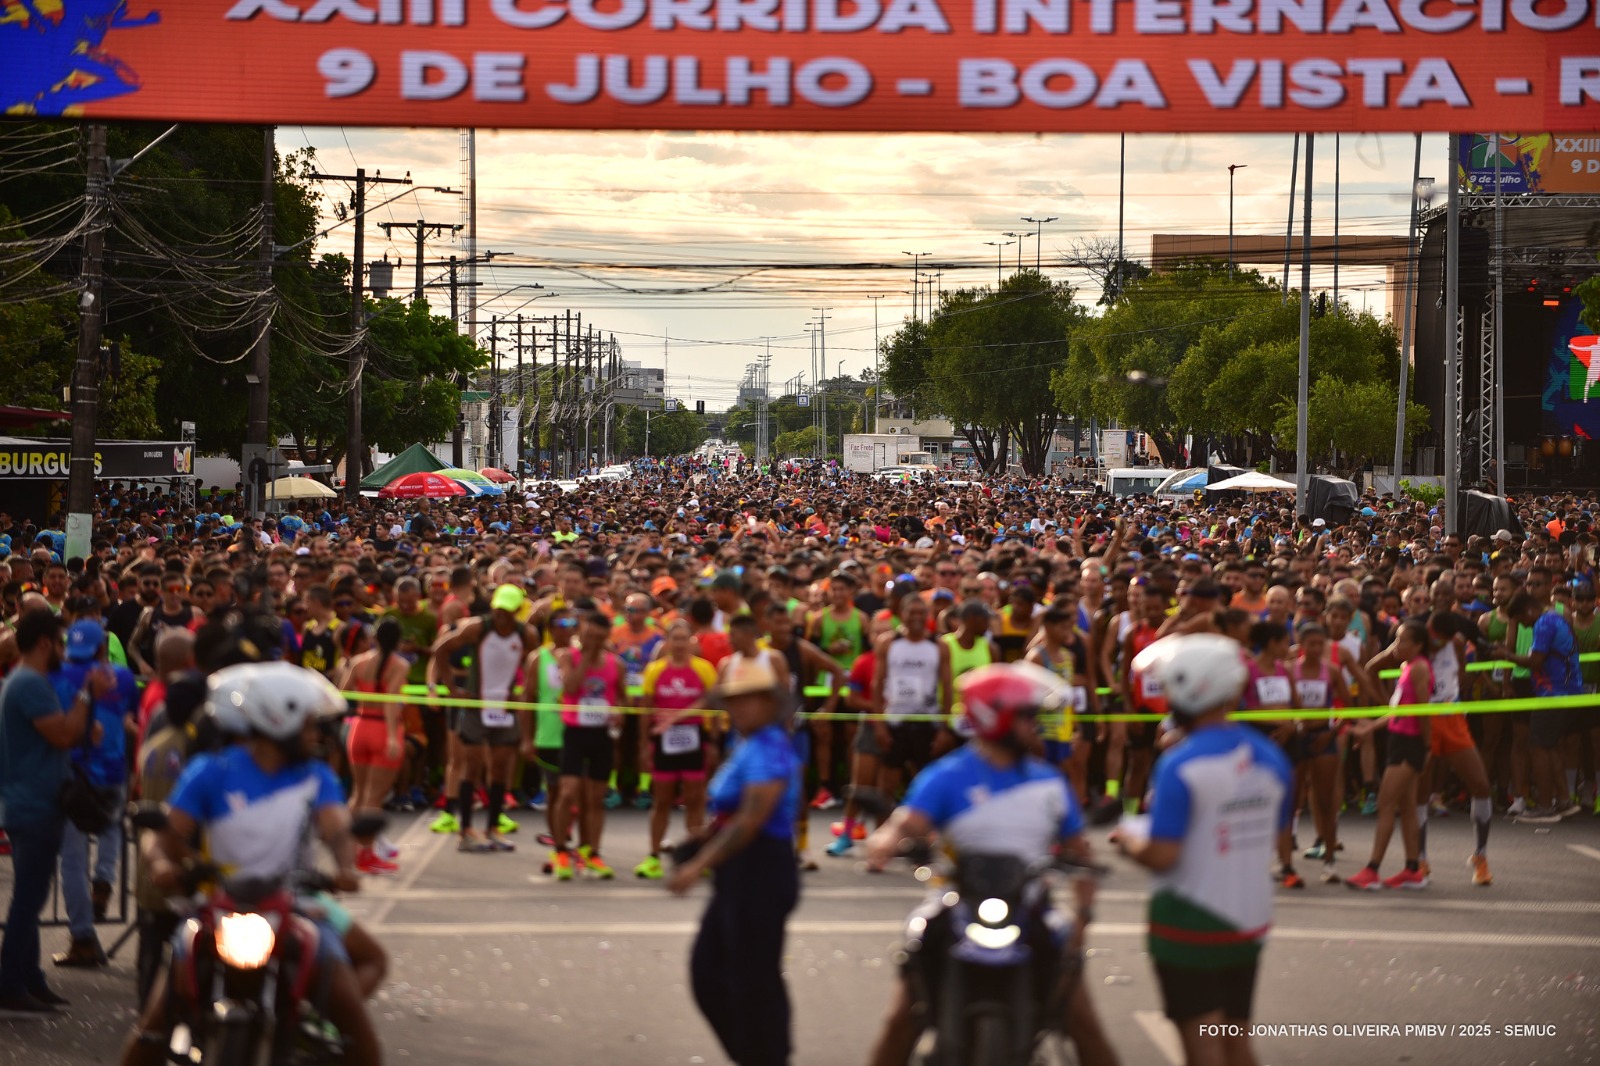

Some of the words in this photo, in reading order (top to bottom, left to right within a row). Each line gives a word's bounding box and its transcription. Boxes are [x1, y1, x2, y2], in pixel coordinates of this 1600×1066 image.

[488, 0, 951, 33] CORRIDA
[973, 0, 1600, 34] INTERNACIO
[316, 47, 377, 98] 9
[401, 50, 526, 101] DE
[545, 54, 874, 107] JULHO
[958, 58, 1168, 109] BOA
[1186, 57, 1472, 109] VISTA
[1554, 138, 1600, 152] XXIII
[1570, 159, 1583, 173] 9
[1469, 175, 1477, 183] 9
[1478, 175, 1491, 183] de
[1493, 175, 1521, 184] ulho
[0, 452, 103, 475] BURGUS
